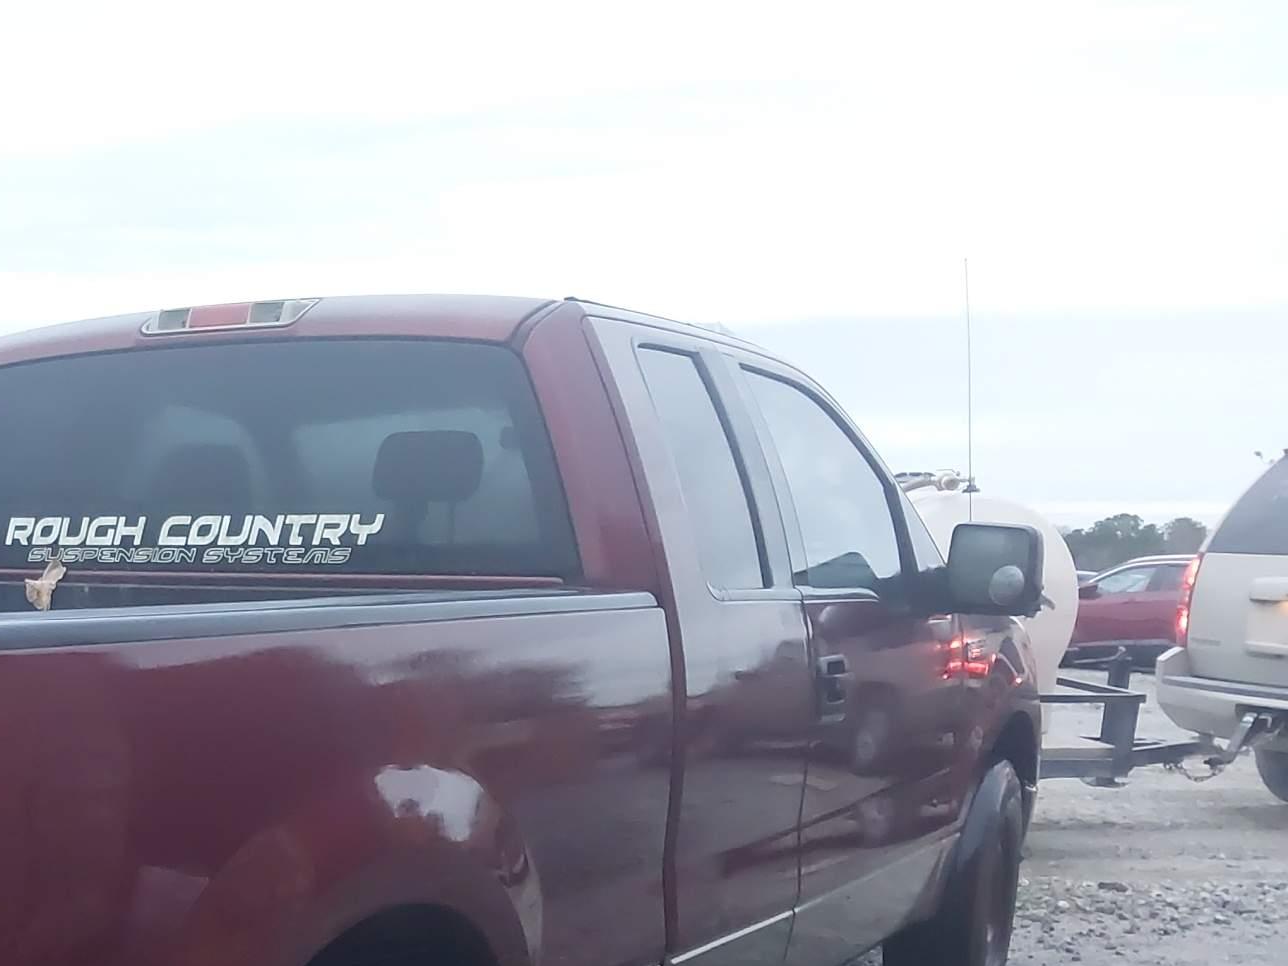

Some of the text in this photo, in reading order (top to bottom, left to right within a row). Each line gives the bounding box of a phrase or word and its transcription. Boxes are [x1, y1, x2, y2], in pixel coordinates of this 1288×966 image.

[4, 513, 386, 546] ROUGH COUNTRY
[27, 546, 353, 564] SUSPENSION SYSTEMS
